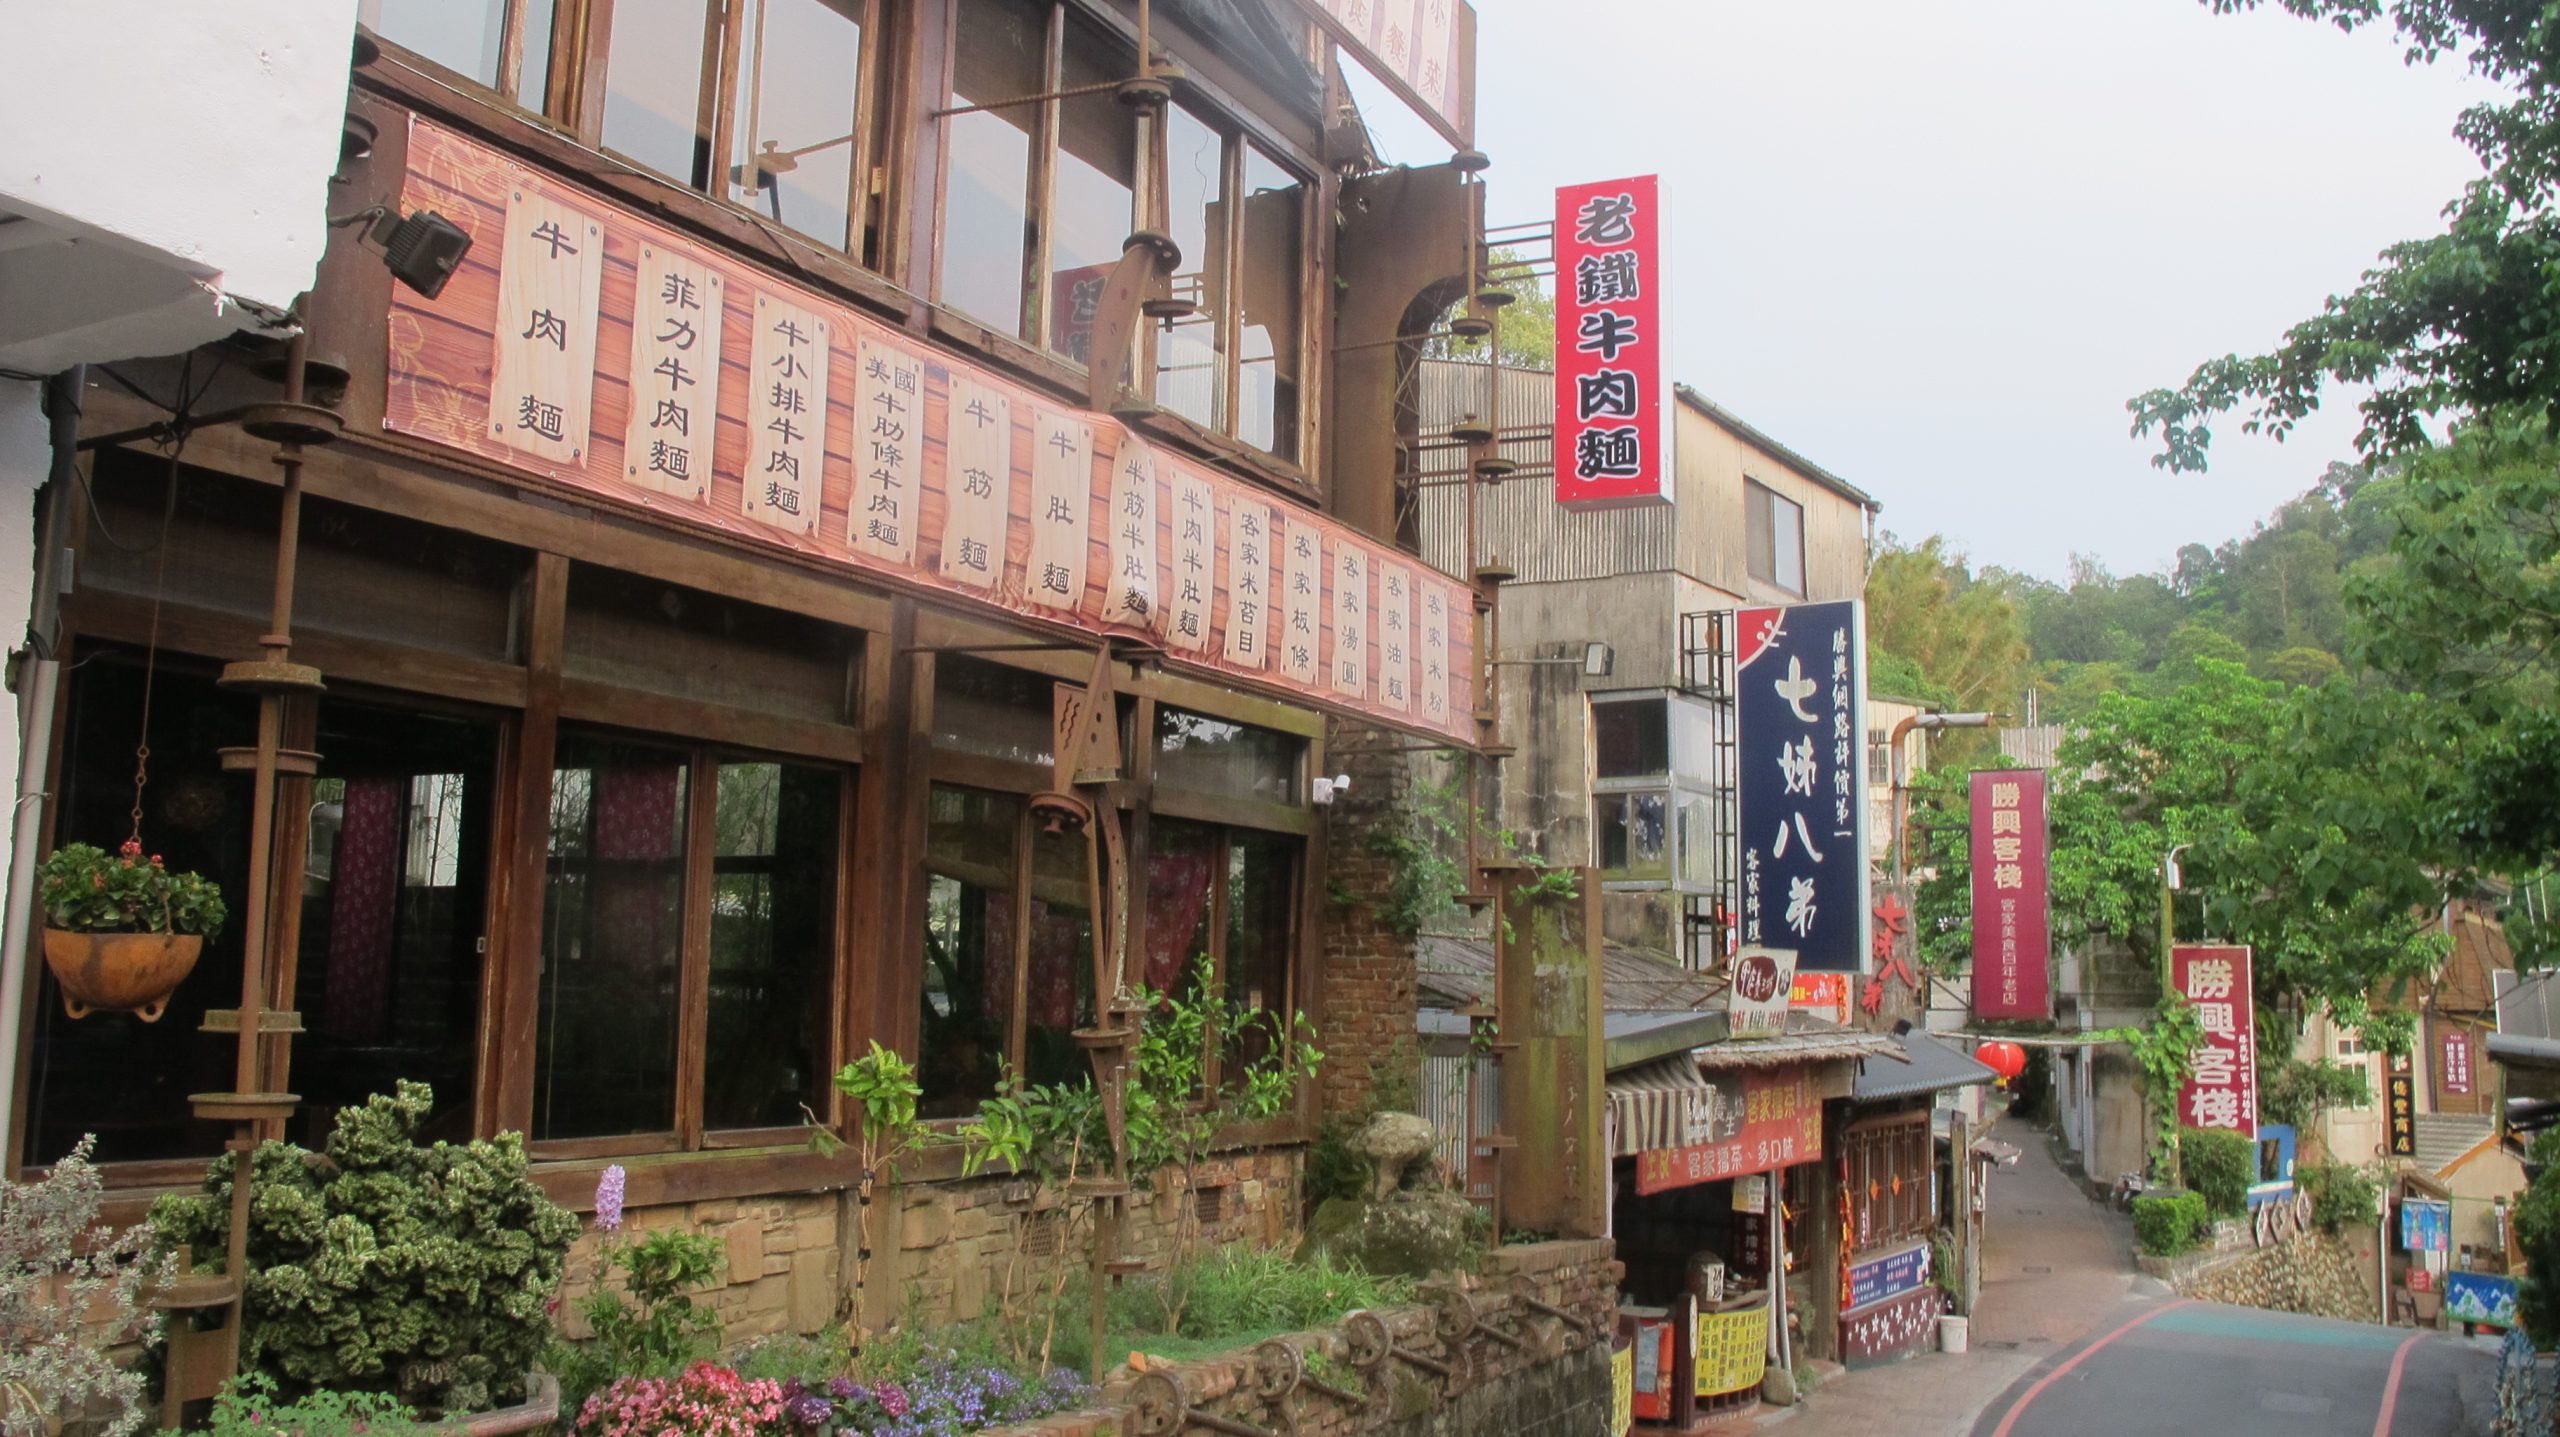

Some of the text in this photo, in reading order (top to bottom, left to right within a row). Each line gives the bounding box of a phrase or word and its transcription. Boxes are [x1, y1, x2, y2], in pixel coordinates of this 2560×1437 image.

[517, 220, 578, 442] 牛肉麵
[648, 272, 702, 481] 菲力牛肉麵
[1576, 193, 1640, 480] 老鐵牛肉麵
[764, 319, 810, 517] 牛小排牛肉麵
[958, 399, 996, 573] 牛筋麵
[1041, 429, 1078, 595] 牛肚麵
[1121, 459, 1149, 616] 半筋半肚麵
[1177, 487, 1204, 638] 半肉半肚麵
[1238, 512, 1261, 654] 客家米苔目
[1291, 534, 1312, 671] 客家板條
[1342, 555, 1360, 687] 客家湯圓
[1386, 575, 1403, 702] 客家油麵
[1427, 594, 1443, 714] 客家米粉
[1773, 655, 1823, 939] 七姊八弟
[1832, 626, 1853, 837] 勝興網路評價第一
[1745, 847, 1761, 942] 客家料理
[1991, 781, 2023, 890] 勝興客棧
[2000, 898, 2017, 1006] 客家美食百年老店
[2187, 958, 2239, 1129] 勝興客棧
